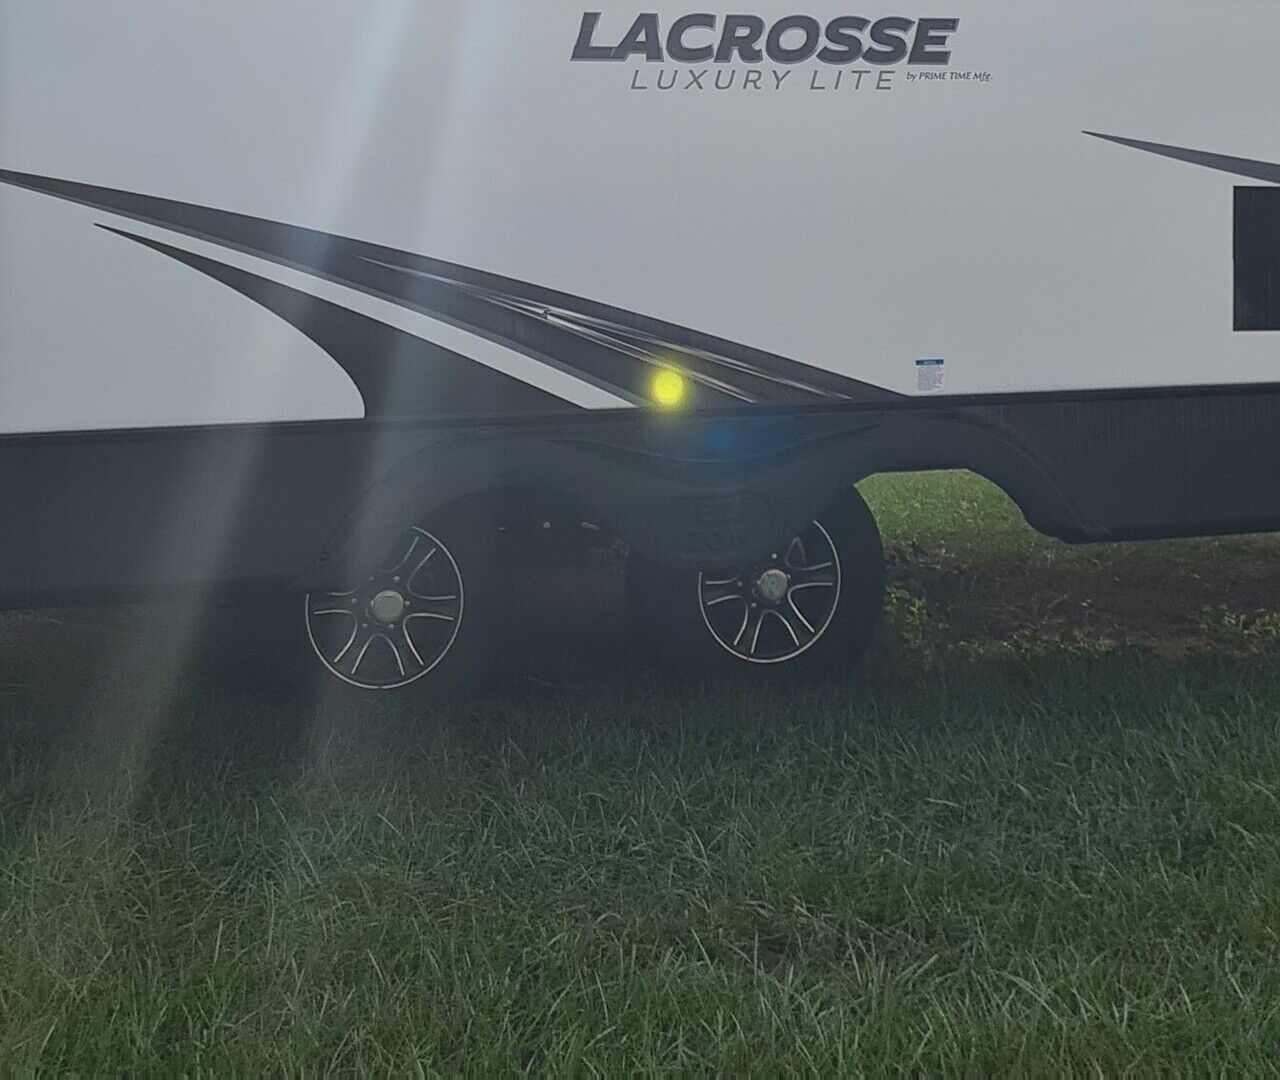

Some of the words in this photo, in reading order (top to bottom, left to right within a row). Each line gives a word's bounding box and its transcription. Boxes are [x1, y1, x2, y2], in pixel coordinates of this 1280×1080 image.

[570, 12, 961, 66] LACROSSE
[631, 69, 792, 90] LUXURY
[810, 70, 897, 91] LITE
[906, 71, 917, 82] by
[919, 71, 948, 81] PRIME
[949, 71, 972, 81] TIME
[972, 71, 994, 82] Mfg.
